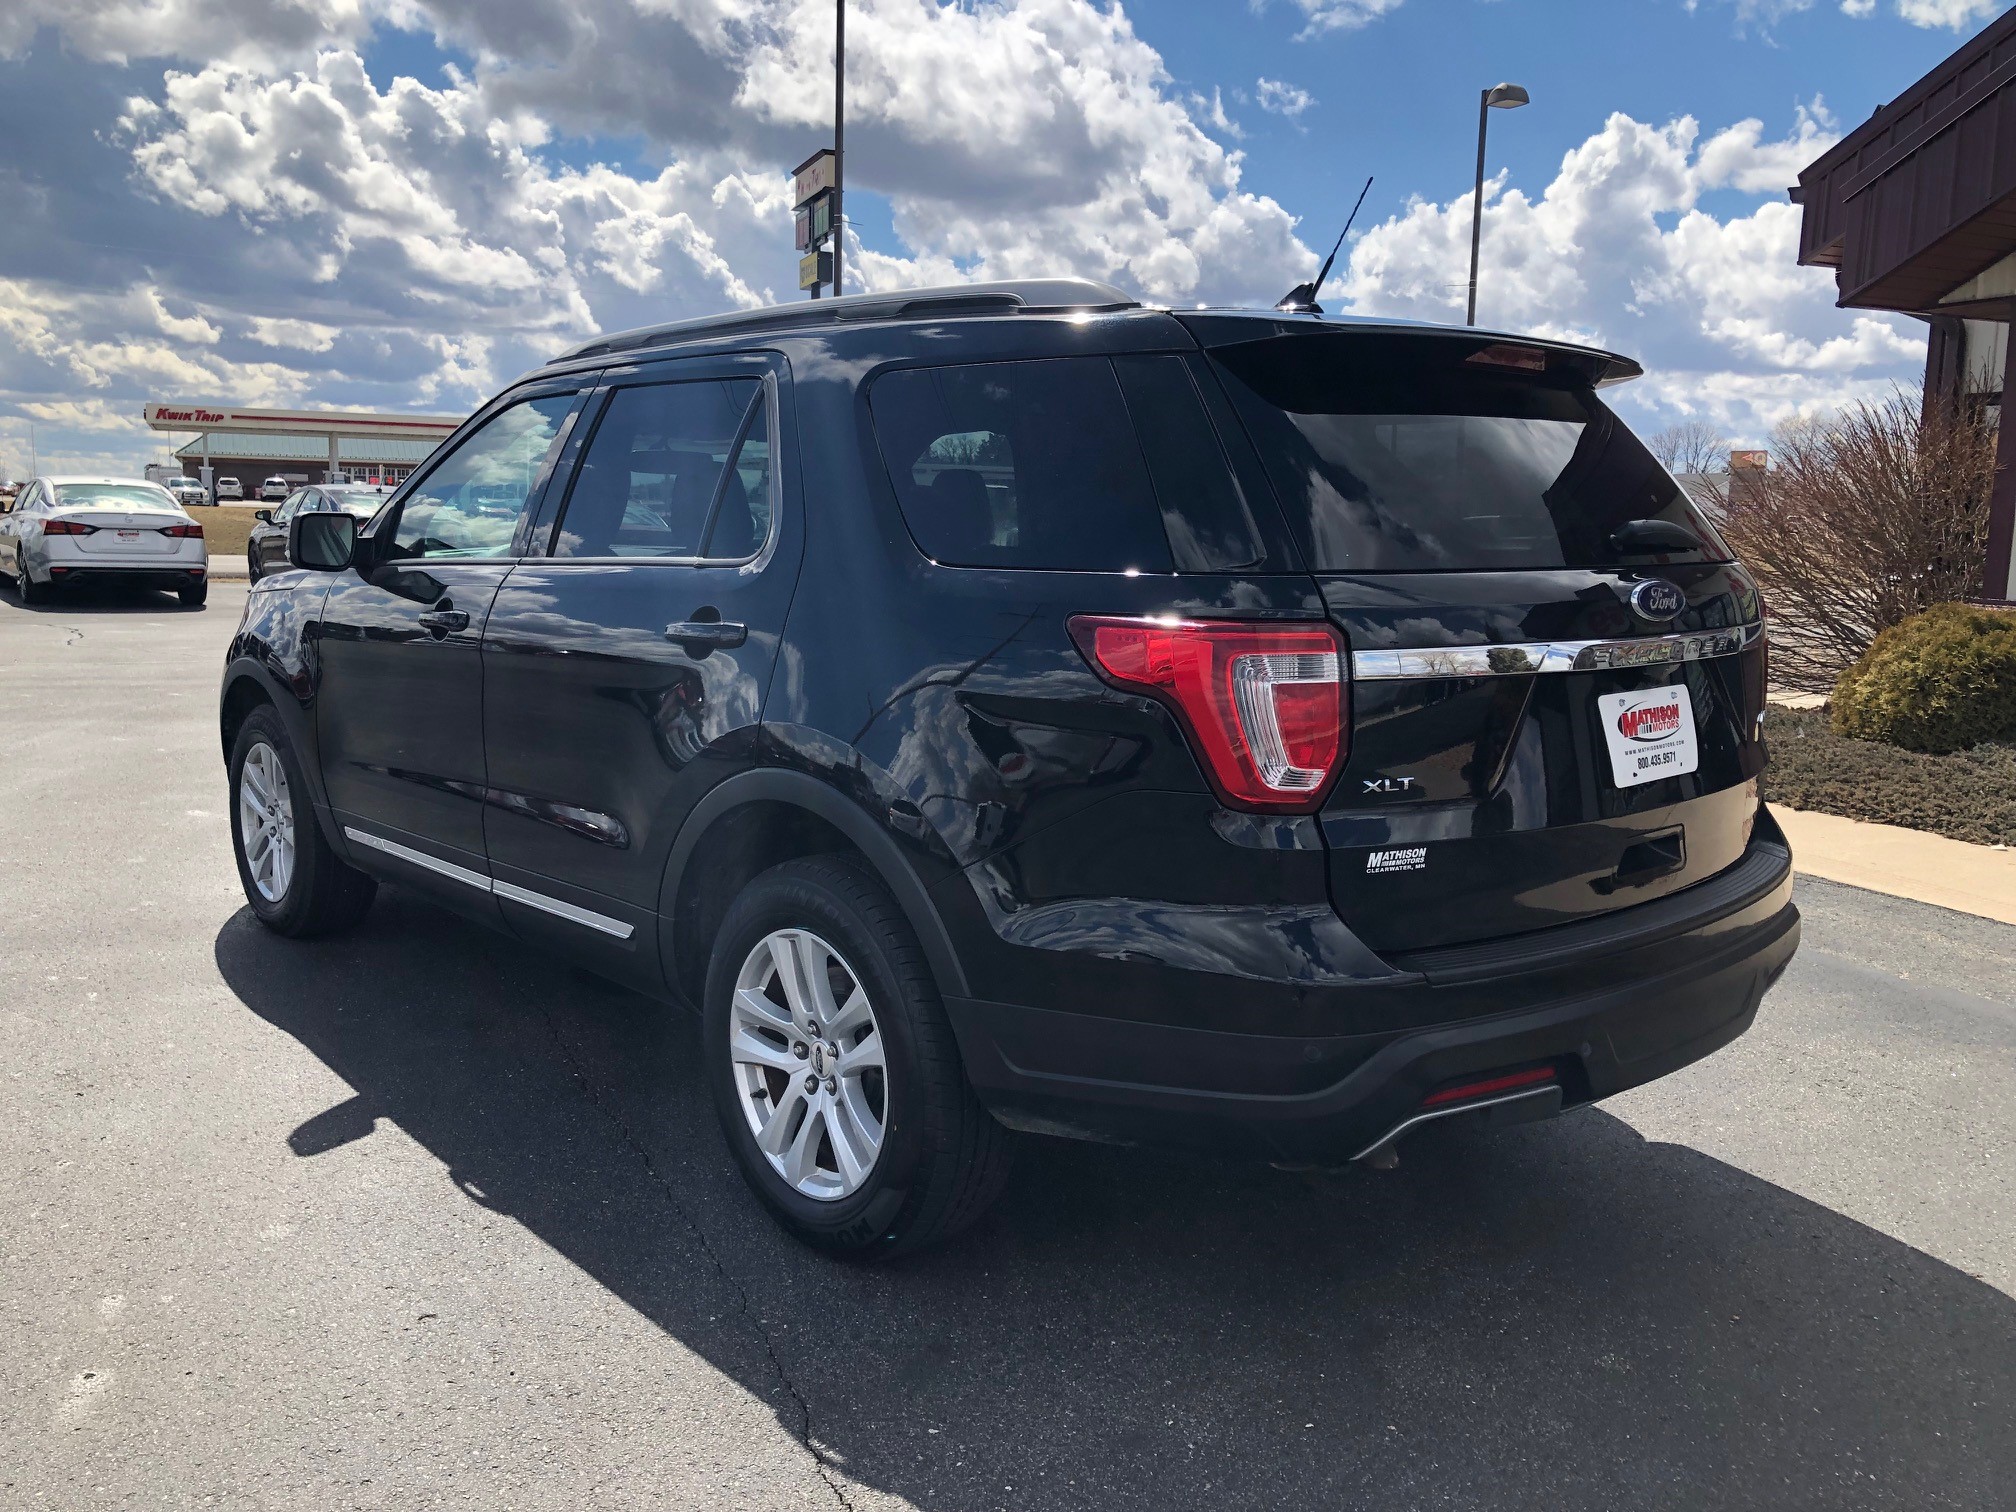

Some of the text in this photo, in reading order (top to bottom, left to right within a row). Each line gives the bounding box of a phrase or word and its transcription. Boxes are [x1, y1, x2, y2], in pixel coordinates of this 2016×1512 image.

[156, 408, 224, 422] KWIK TRIP
[1650, 586, 1678, 610] Ford
[1622, 704, 1680, 738] MATHISON
[1652, 721, 1680, 733] MOTORS
[1637, 751, 1676, 769] 800.435.9571
[1362, 777, 1415, 794] XLT
[1366, 847, 1427, 868] MATHISON
[1396, 857, 1425, 866] MOTORS
[1366, 864, 1414, 874] CLEARWATER,
